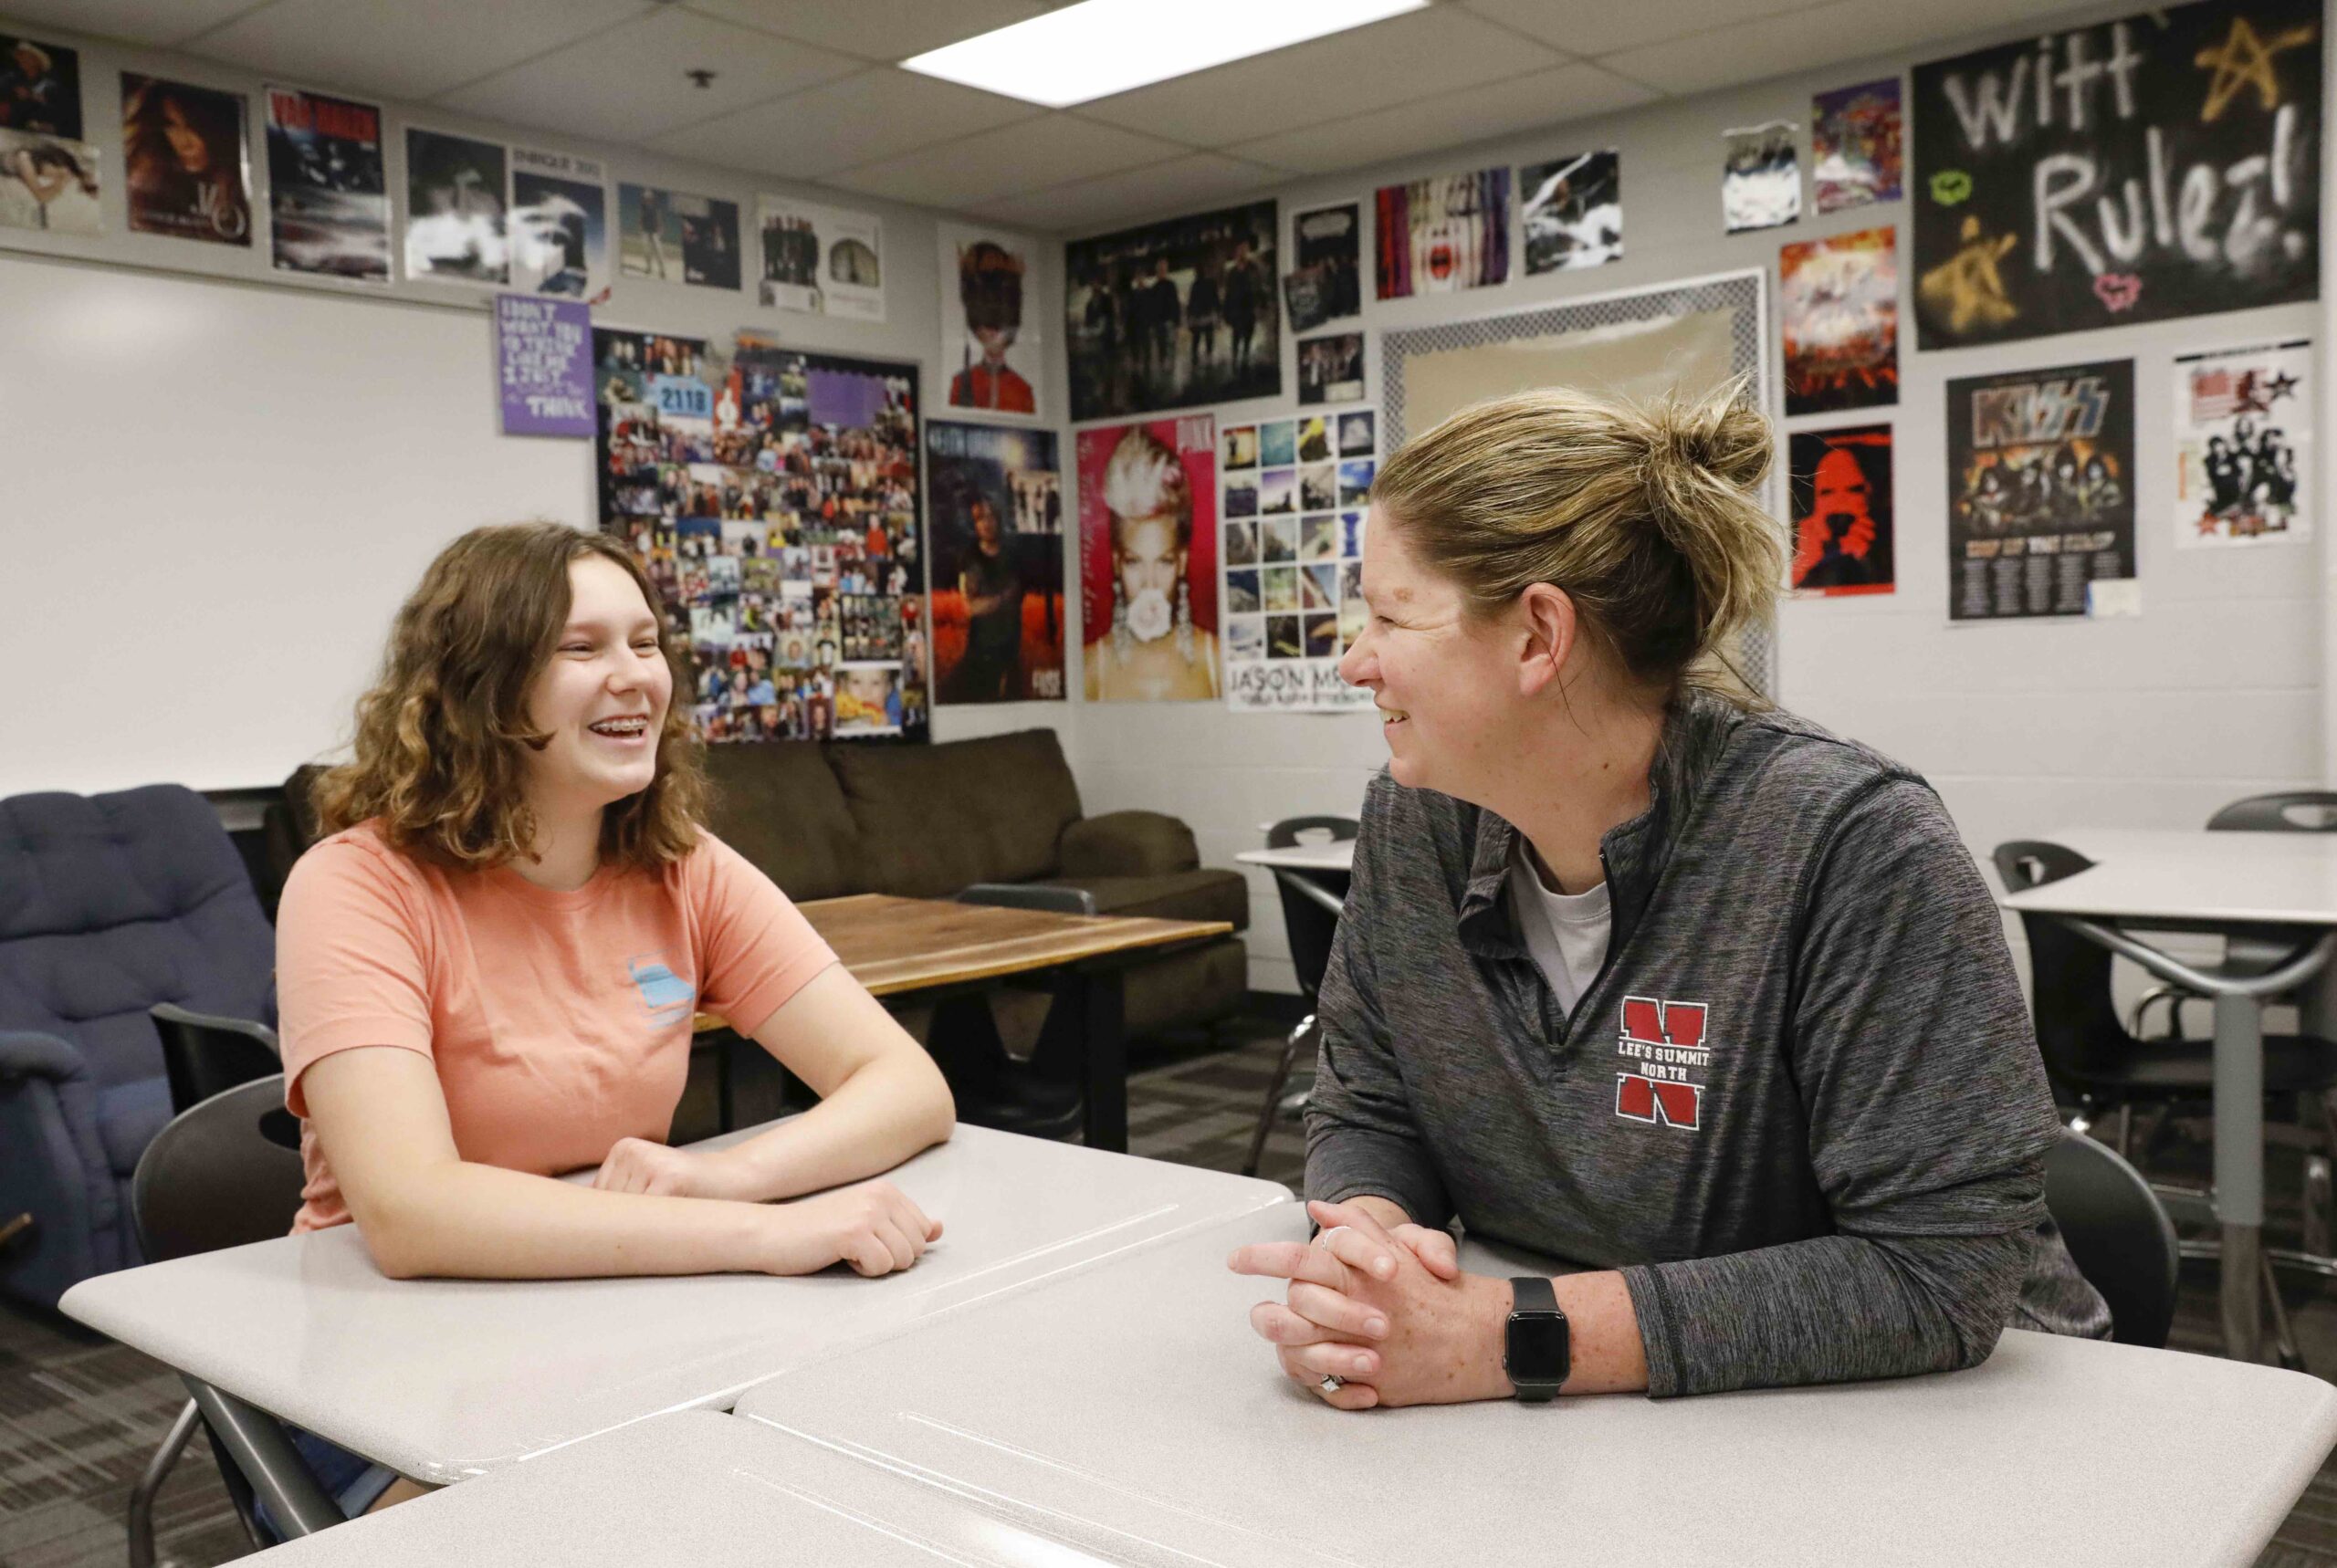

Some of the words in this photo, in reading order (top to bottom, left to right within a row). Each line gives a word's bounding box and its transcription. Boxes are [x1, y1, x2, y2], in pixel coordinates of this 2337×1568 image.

[1943, 20, 2144, 152] Witt
[1971, 375, 2111, 449] KISS
[1231, 665, 1305, 691] JASON
[1618, 1041, 1652, 1060] LEE'S
[1655, 1047, 1710, 1067] SUMMIT
[1640, 1061, 1688, 1082] NORTH
